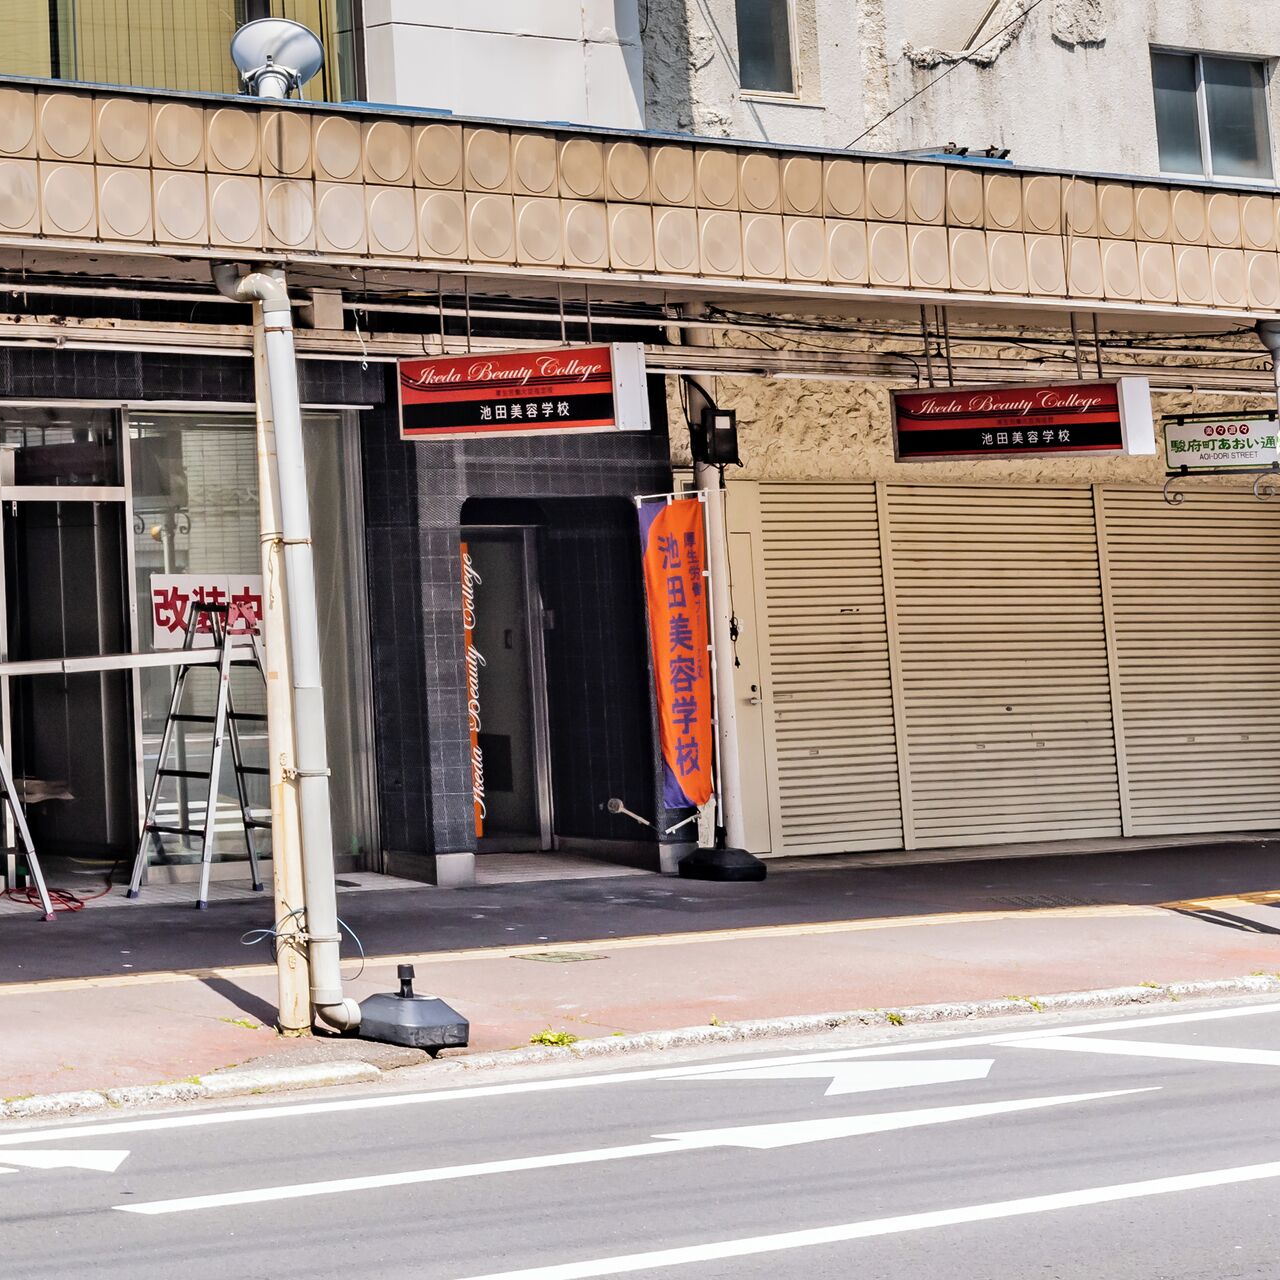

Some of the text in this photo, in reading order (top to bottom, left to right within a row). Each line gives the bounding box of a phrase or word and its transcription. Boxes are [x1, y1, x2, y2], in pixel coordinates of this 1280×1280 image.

[410, 356, 602, 386] Ikeda Beauty College
[479, 401, 570, 420] 池田美容学校
[911, 390, 1103, 416] Ikeda Beauty College
[981, 429, 1071, 446] 池田美容学校
[1170, 435, 1279, 454] 駿府町あおい通
[1200, 450, 1259, 461] AOI-DORI STREET
[153, 586, 264, 634] 改装中
[657, 532, 701, 777] 池田美容学校
